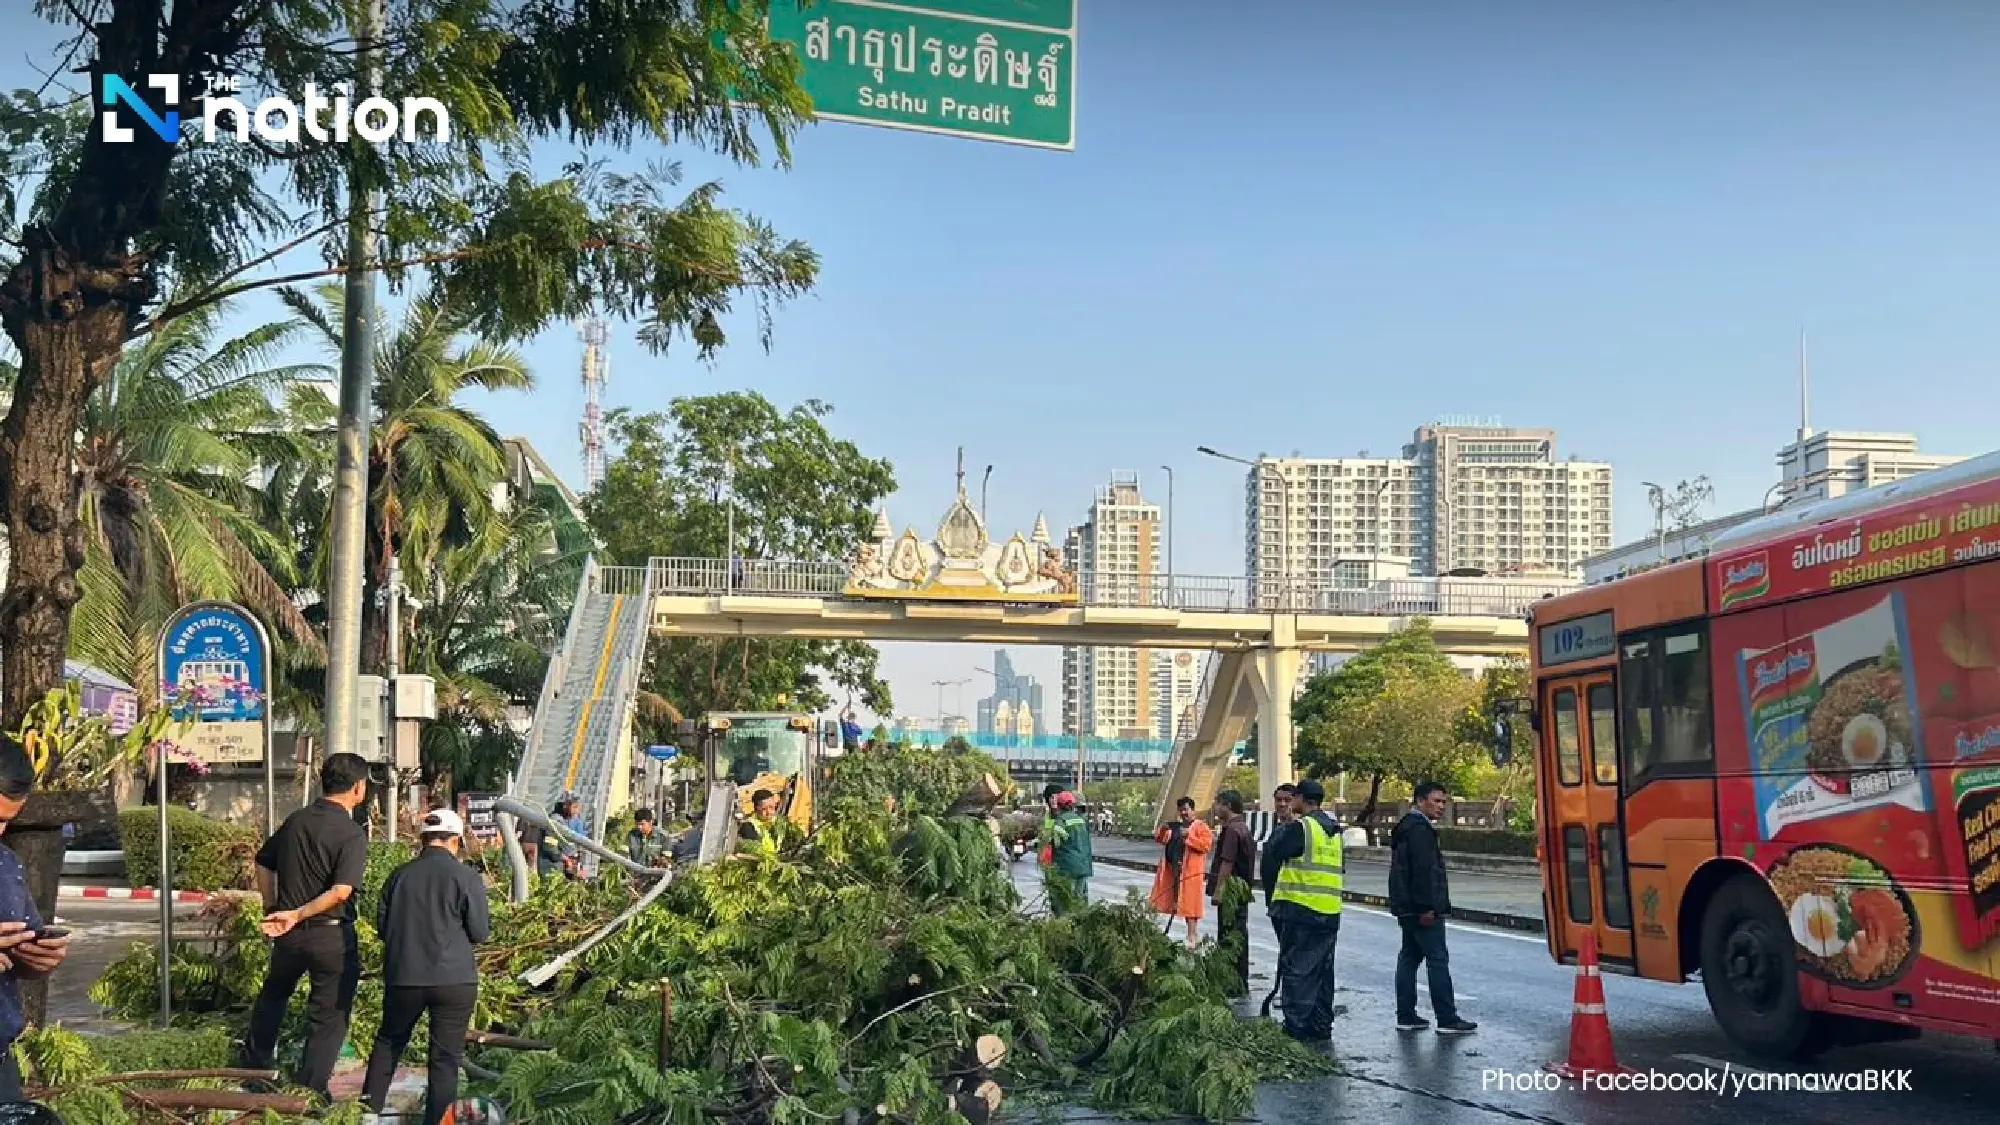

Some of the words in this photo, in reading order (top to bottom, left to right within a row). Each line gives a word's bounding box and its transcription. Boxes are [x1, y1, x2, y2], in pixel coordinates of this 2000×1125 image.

[805, 16, 1064, 107] สาธุประดิษฐ์
[857, 85, 928, 114] Sathu
[941, 96, 1012, 126] Pradit
[1791, 519, 1861, 570] อินโดหมี่
[1828, 545, 1947, 587] อร่อยครบรส
[1553, 625, 1584, 656] 102
